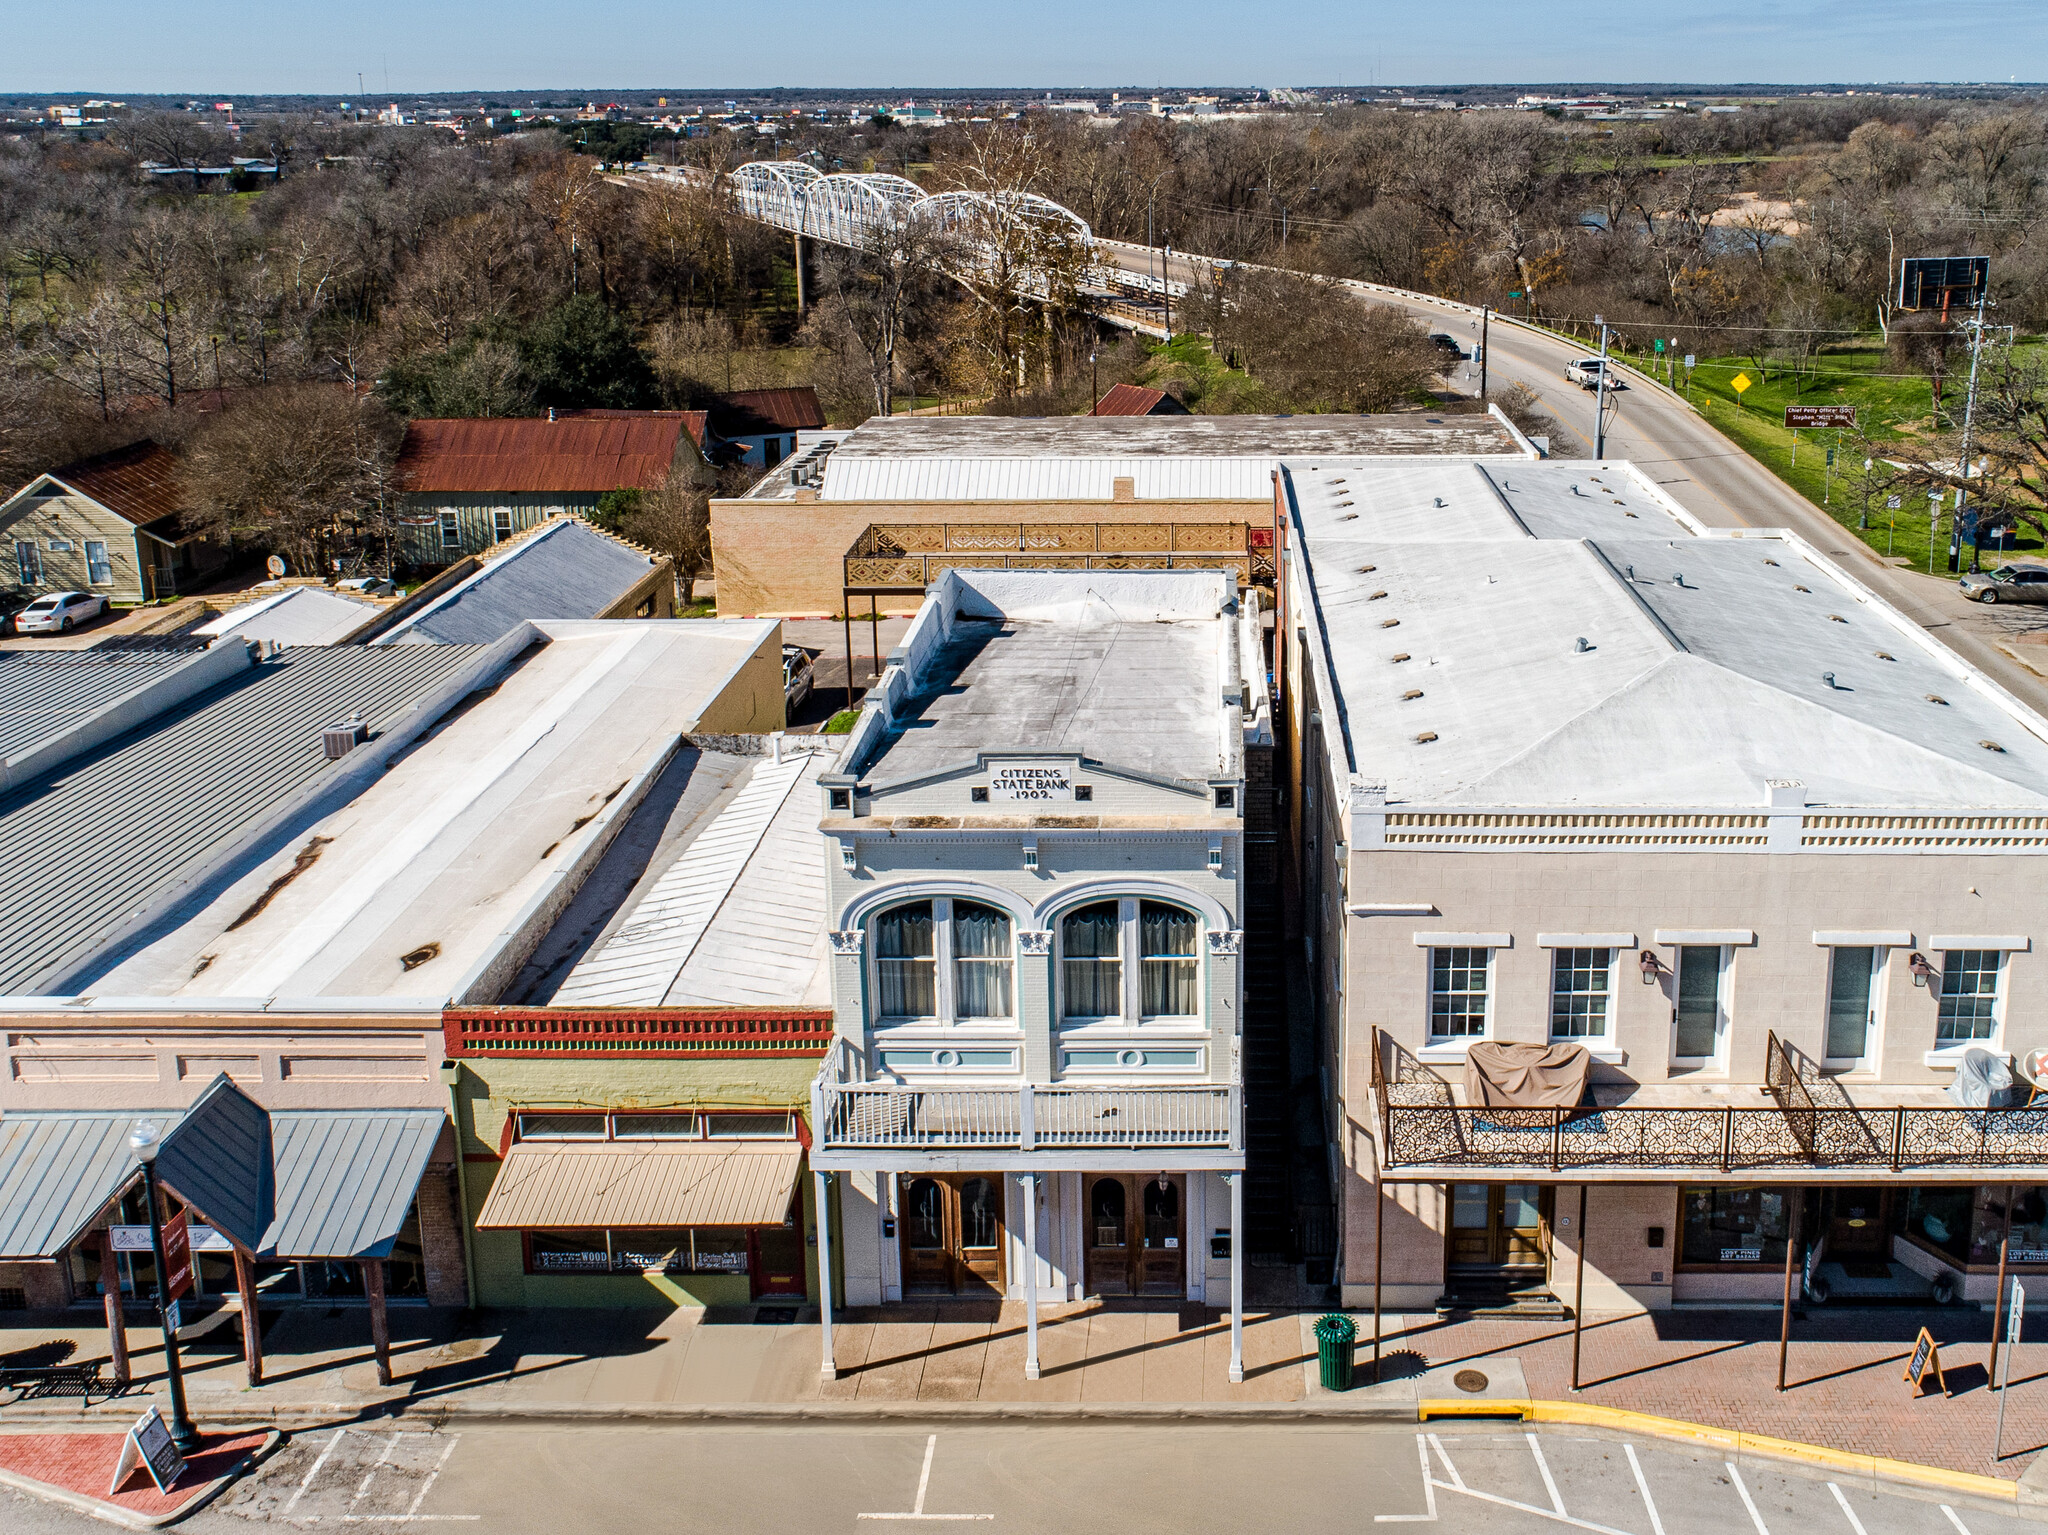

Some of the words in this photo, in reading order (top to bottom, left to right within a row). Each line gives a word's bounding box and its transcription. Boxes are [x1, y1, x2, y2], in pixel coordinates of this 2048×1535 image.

[1000, 769, 1062, 778] CITIZENS
[992, 779, 1035, 790] STATE
[1036, 779, 1071, 790] BANK
[580, 1251, 608, 1262] WOOD
